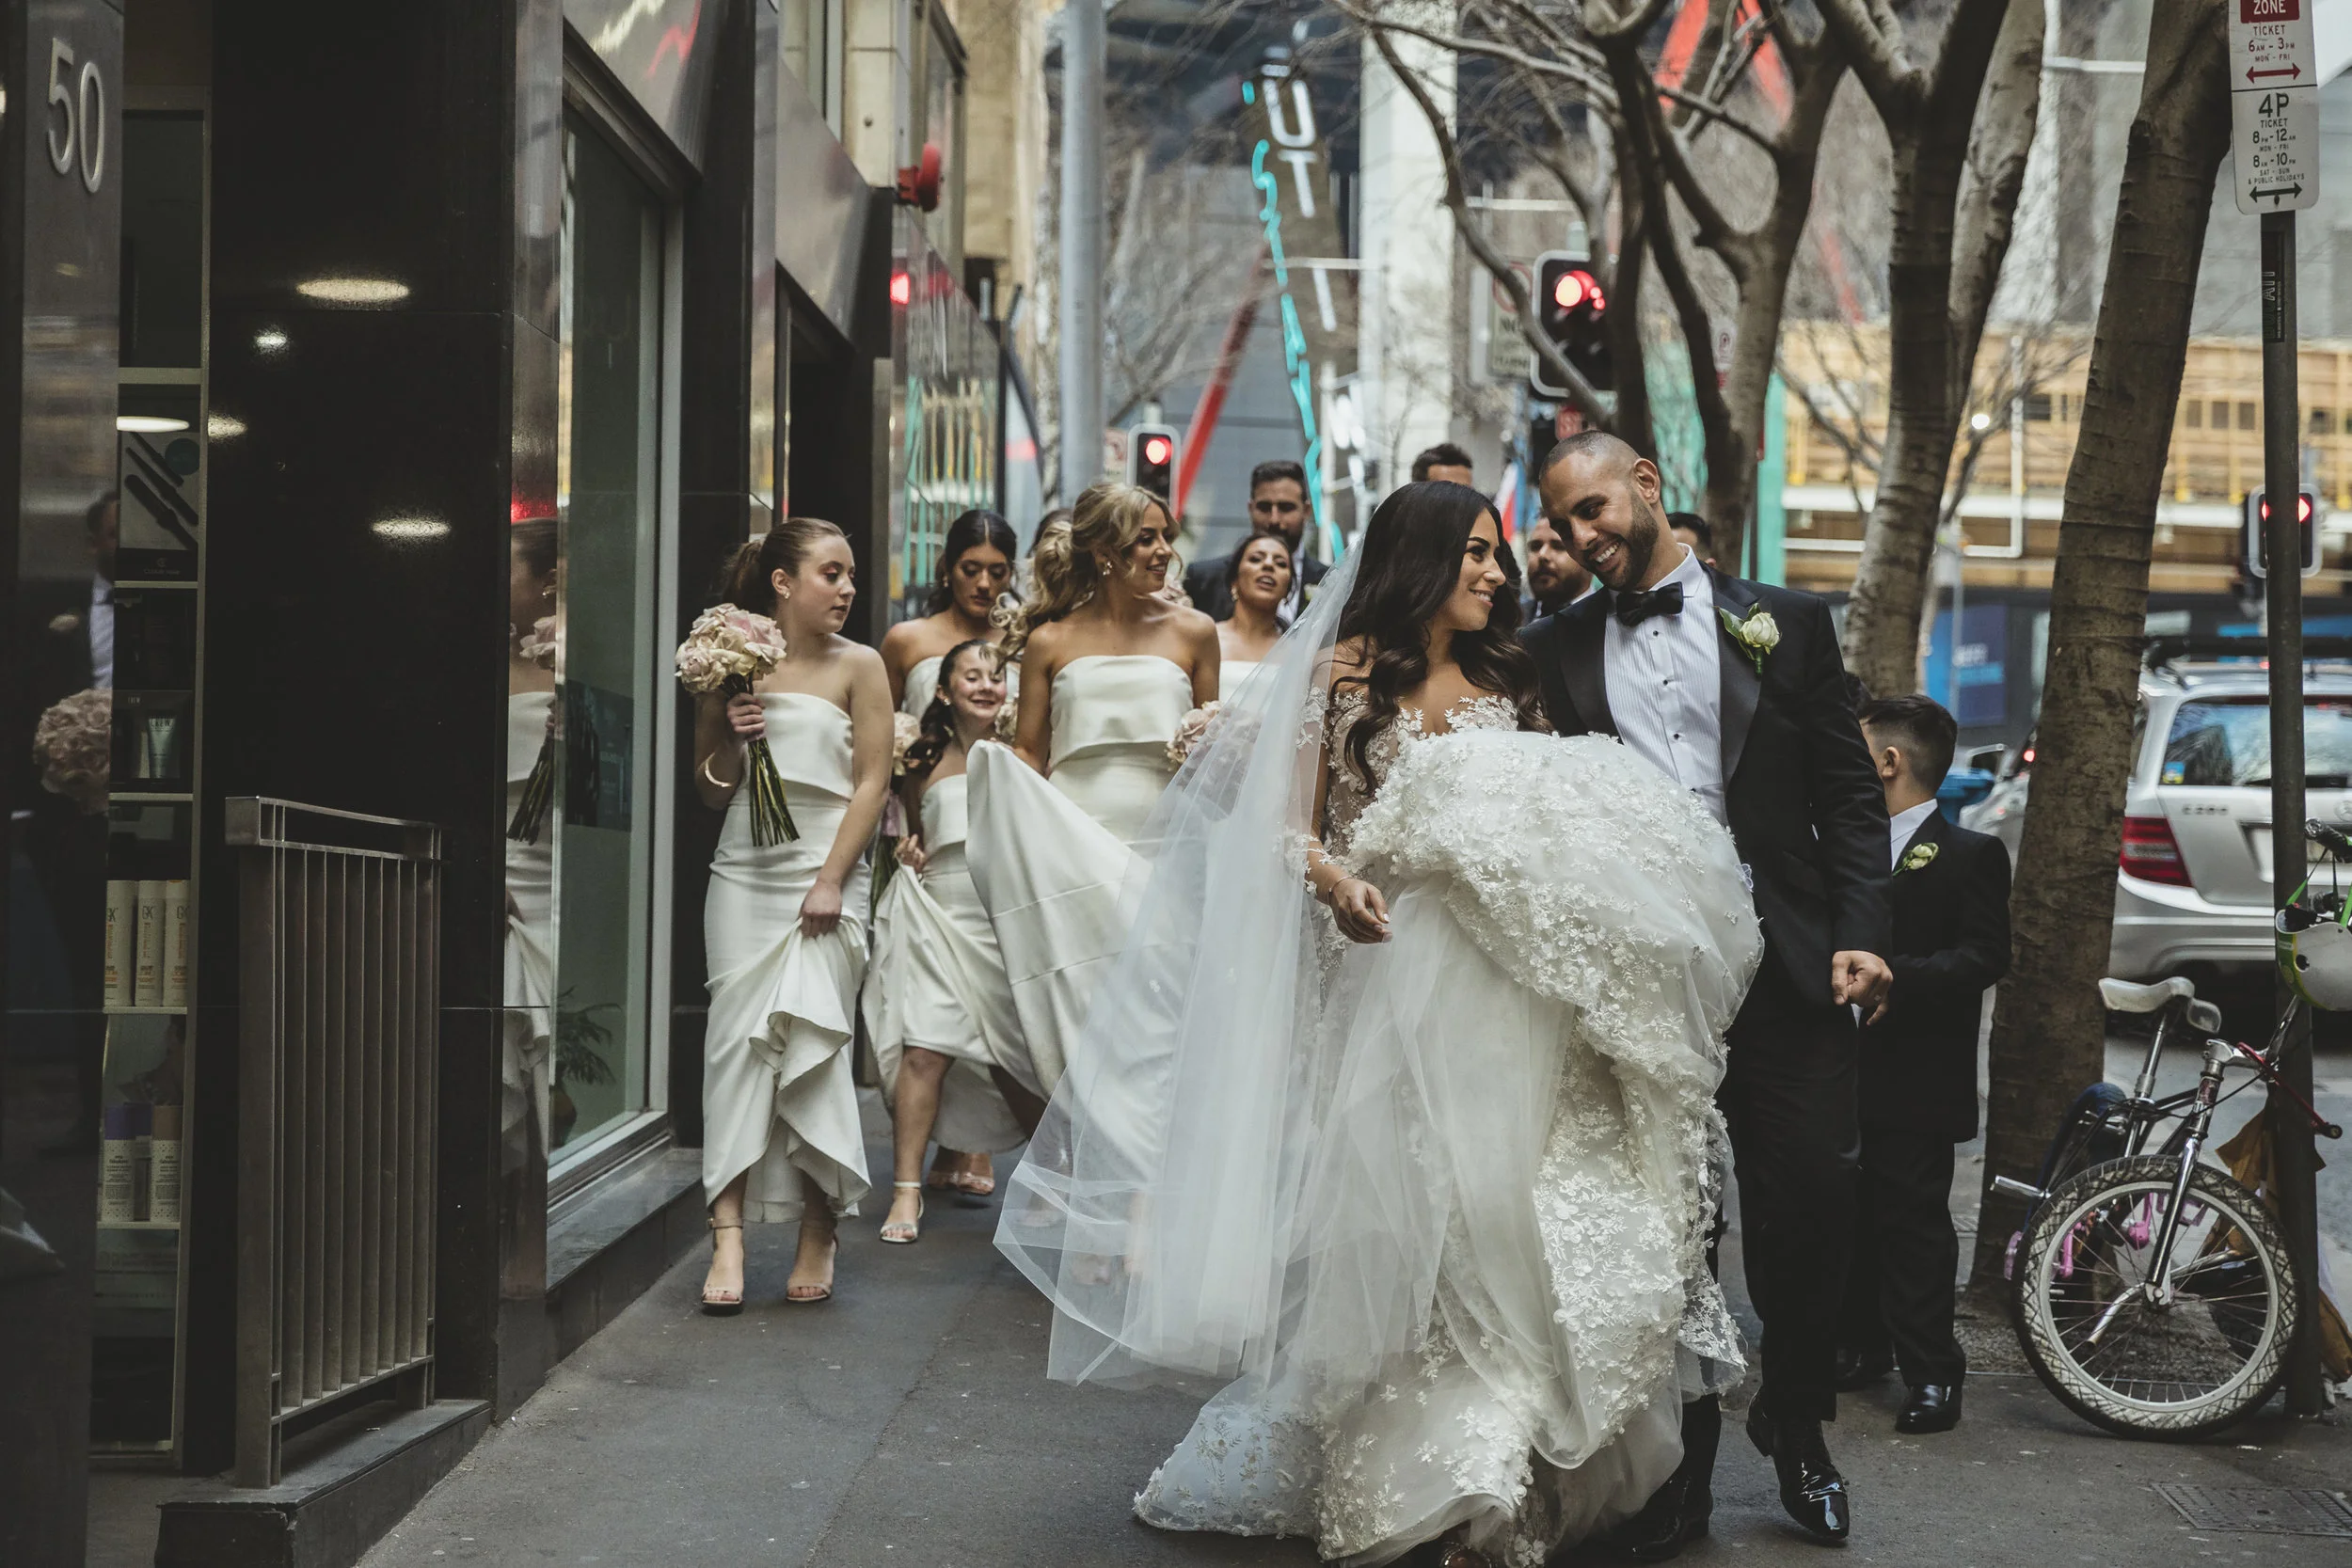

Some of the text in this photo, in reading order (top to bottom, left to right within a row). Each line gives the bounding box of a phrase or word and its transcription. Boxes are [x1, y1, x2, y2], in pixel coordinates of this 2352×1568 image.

[2253, 0, 2286, 15] ZONE
[2253, 24, 2285, 36] TICKET
[2258, 92, 2290, 119] 4P
[48, 38, 104, 193] 50
[2260, 118, 2288, 128] TICKET
